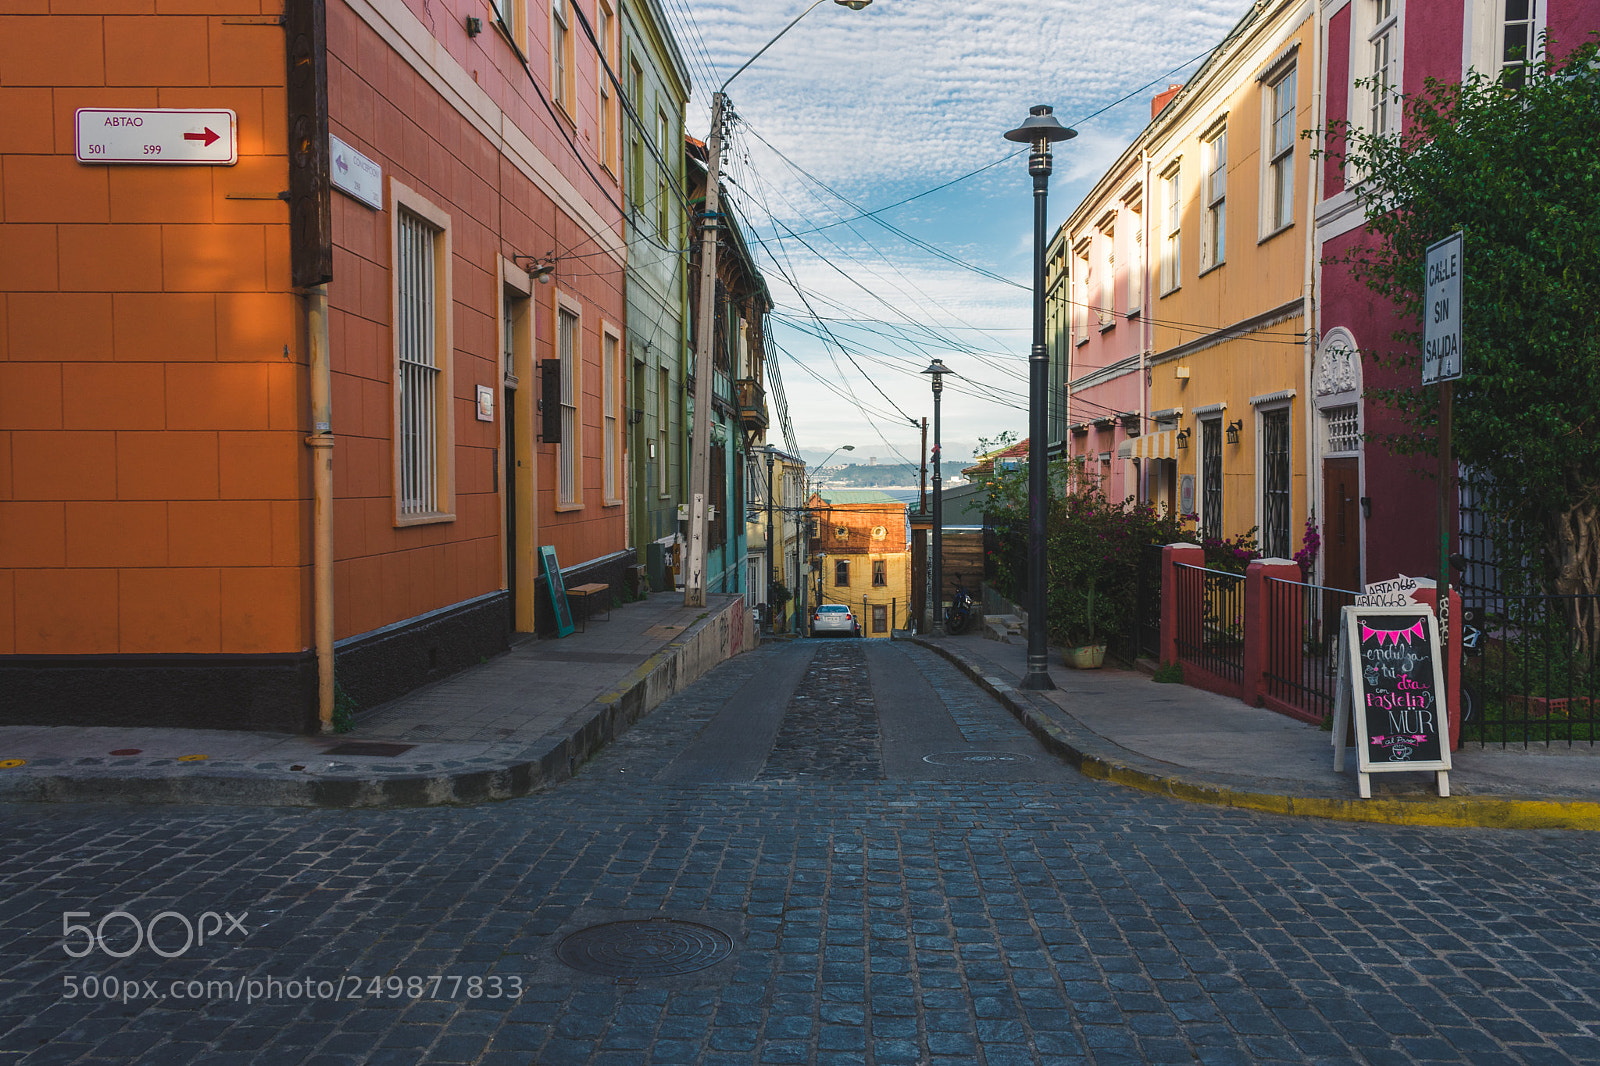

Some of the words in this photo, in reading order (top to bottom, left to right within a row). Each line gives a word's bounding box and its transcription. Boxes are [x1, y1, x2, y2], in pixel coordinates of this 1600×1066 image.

[104, 117, 144, 127] ABTAO
[88, 145, 106, 154] 501
[143, 145, 162, 155] 599
[1429, 254, 1456, 287] CALLE
[1434, 298, 1449, 324] SIN
[1426, 333, 1458, 362] SALIDA
[1375, 687, 1390, 695] con
[1388, 706, 1435, 735] MÜR
[1384, 737, 1395, 745] al
